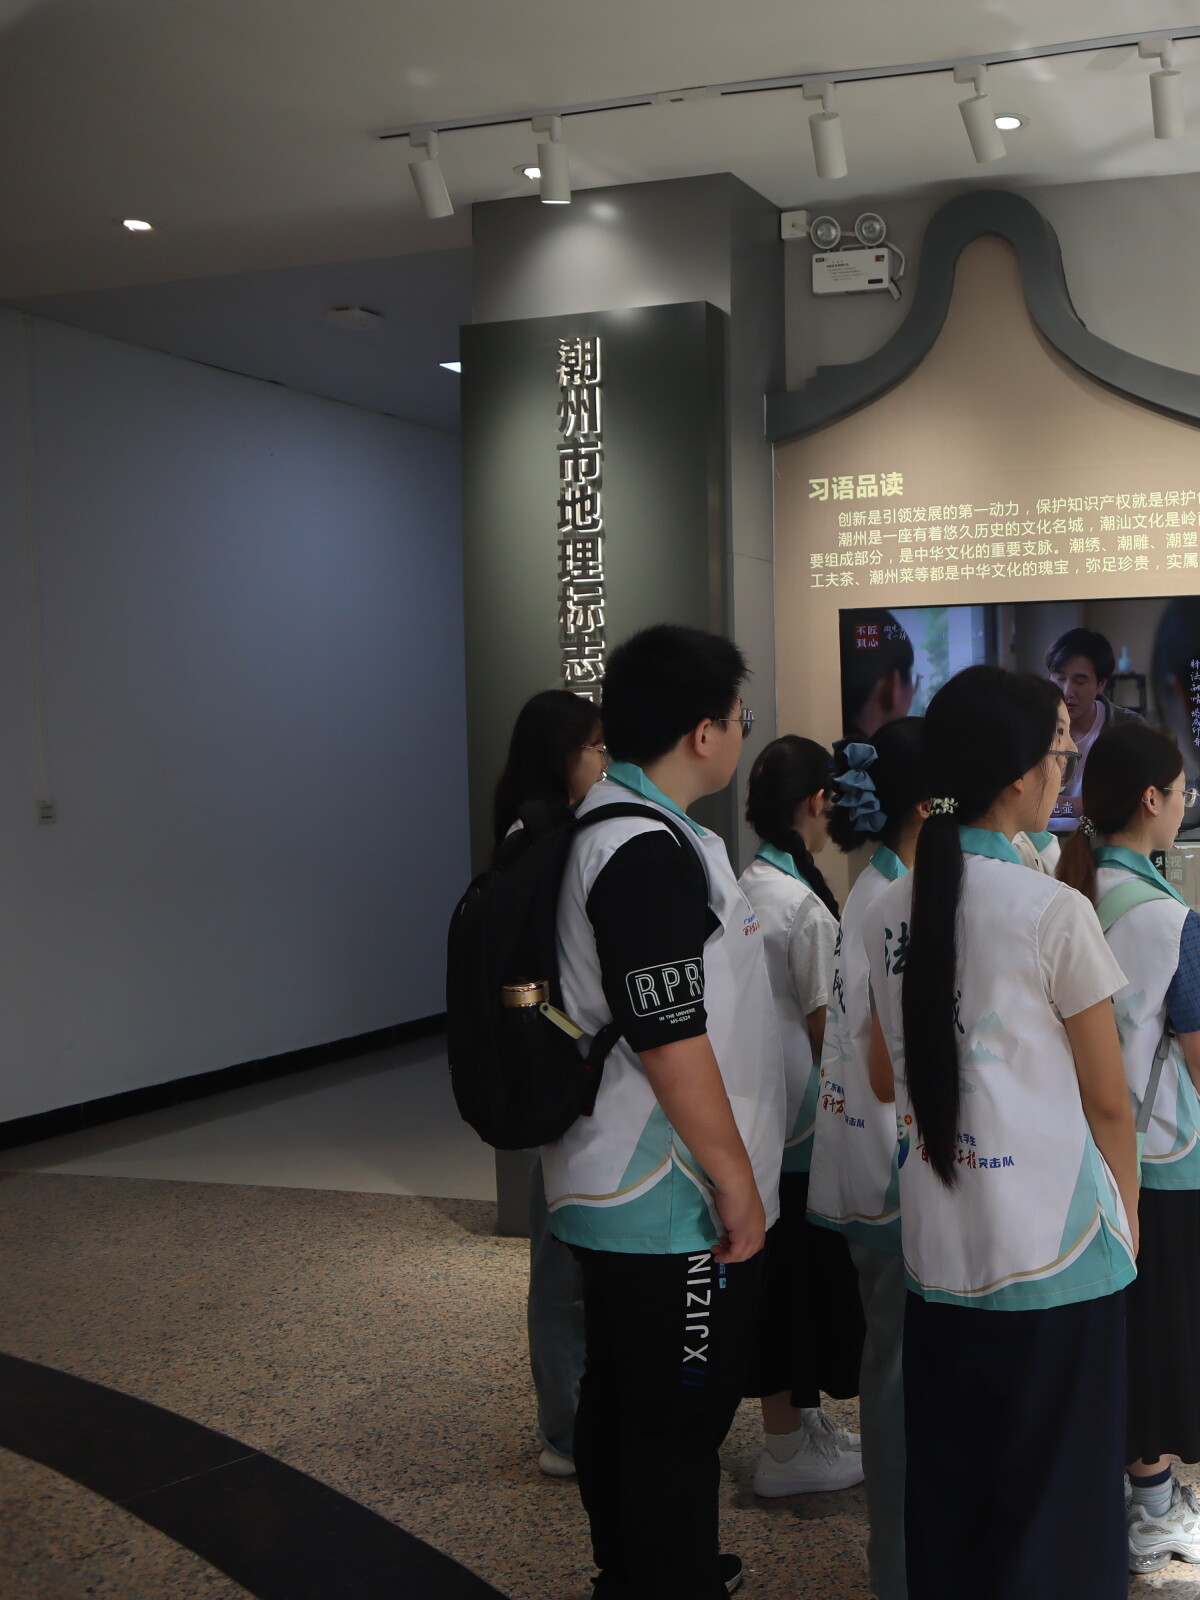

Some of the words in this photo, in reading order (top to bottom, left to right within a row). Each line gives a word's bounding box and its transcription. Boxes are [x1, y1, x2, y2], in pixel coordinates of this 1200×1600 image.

[808, 471, 904, 501] 习语品读
[978, 1155, 1015, 1169] 突击队
